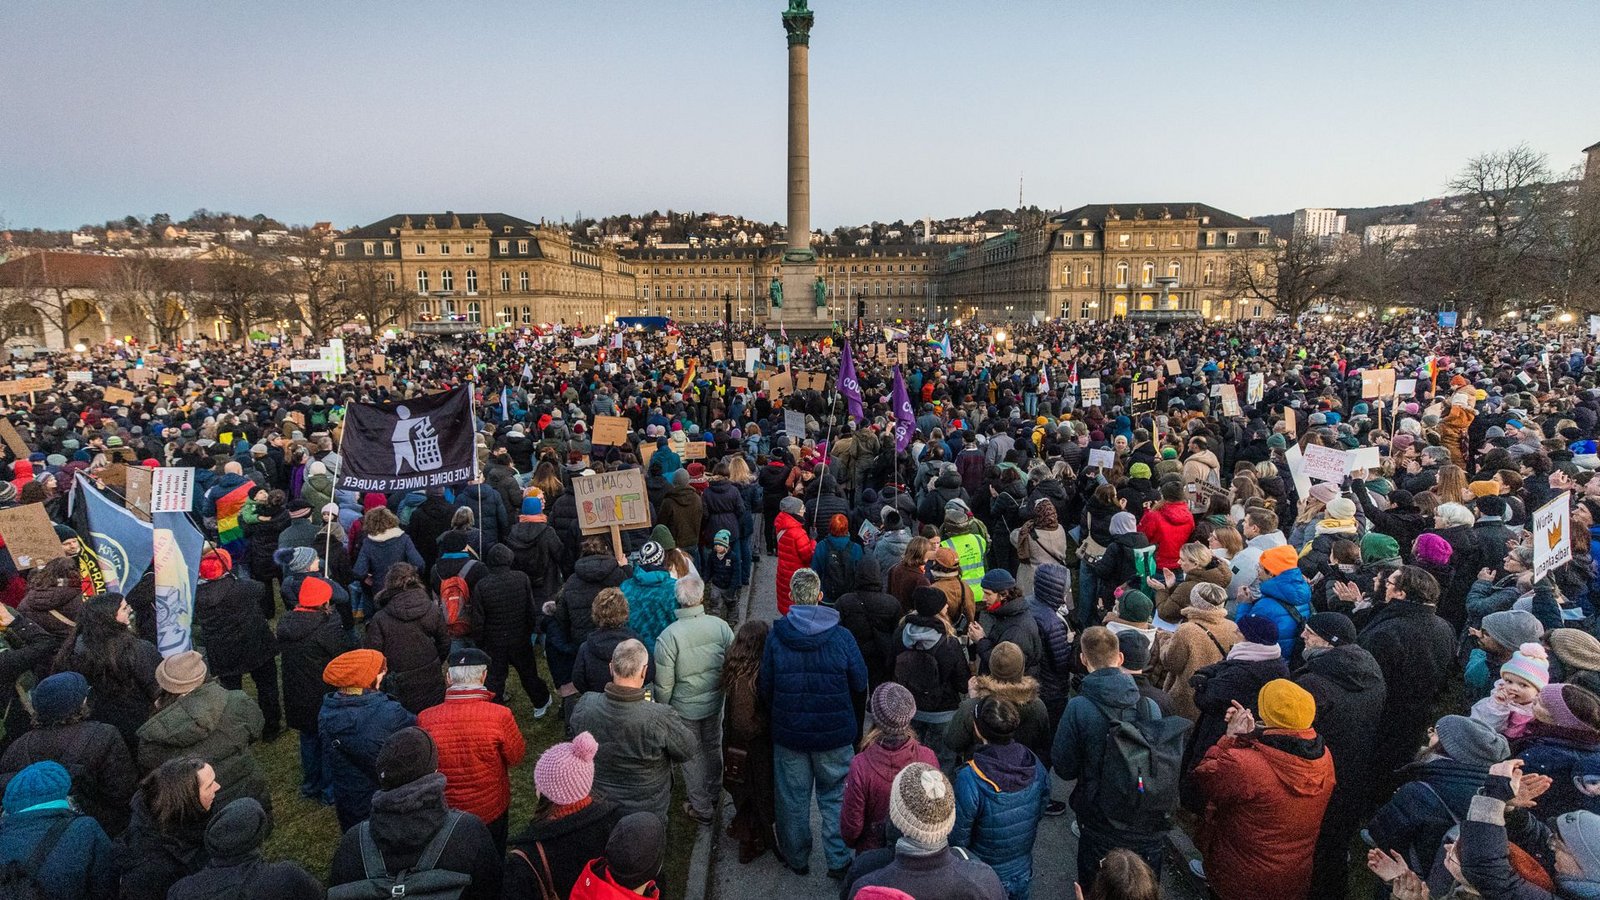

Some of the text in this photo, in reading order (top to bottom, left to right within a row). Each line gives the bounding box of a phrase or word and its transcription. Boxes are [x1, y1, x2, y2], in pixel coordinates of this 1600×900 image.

[577, 477, 595, 496] ICH
[582, 493, 640, 525] BUNT
[1535, 512, 1553, 531] Würde
[1536, 546, 1569, 576] unantastbar
